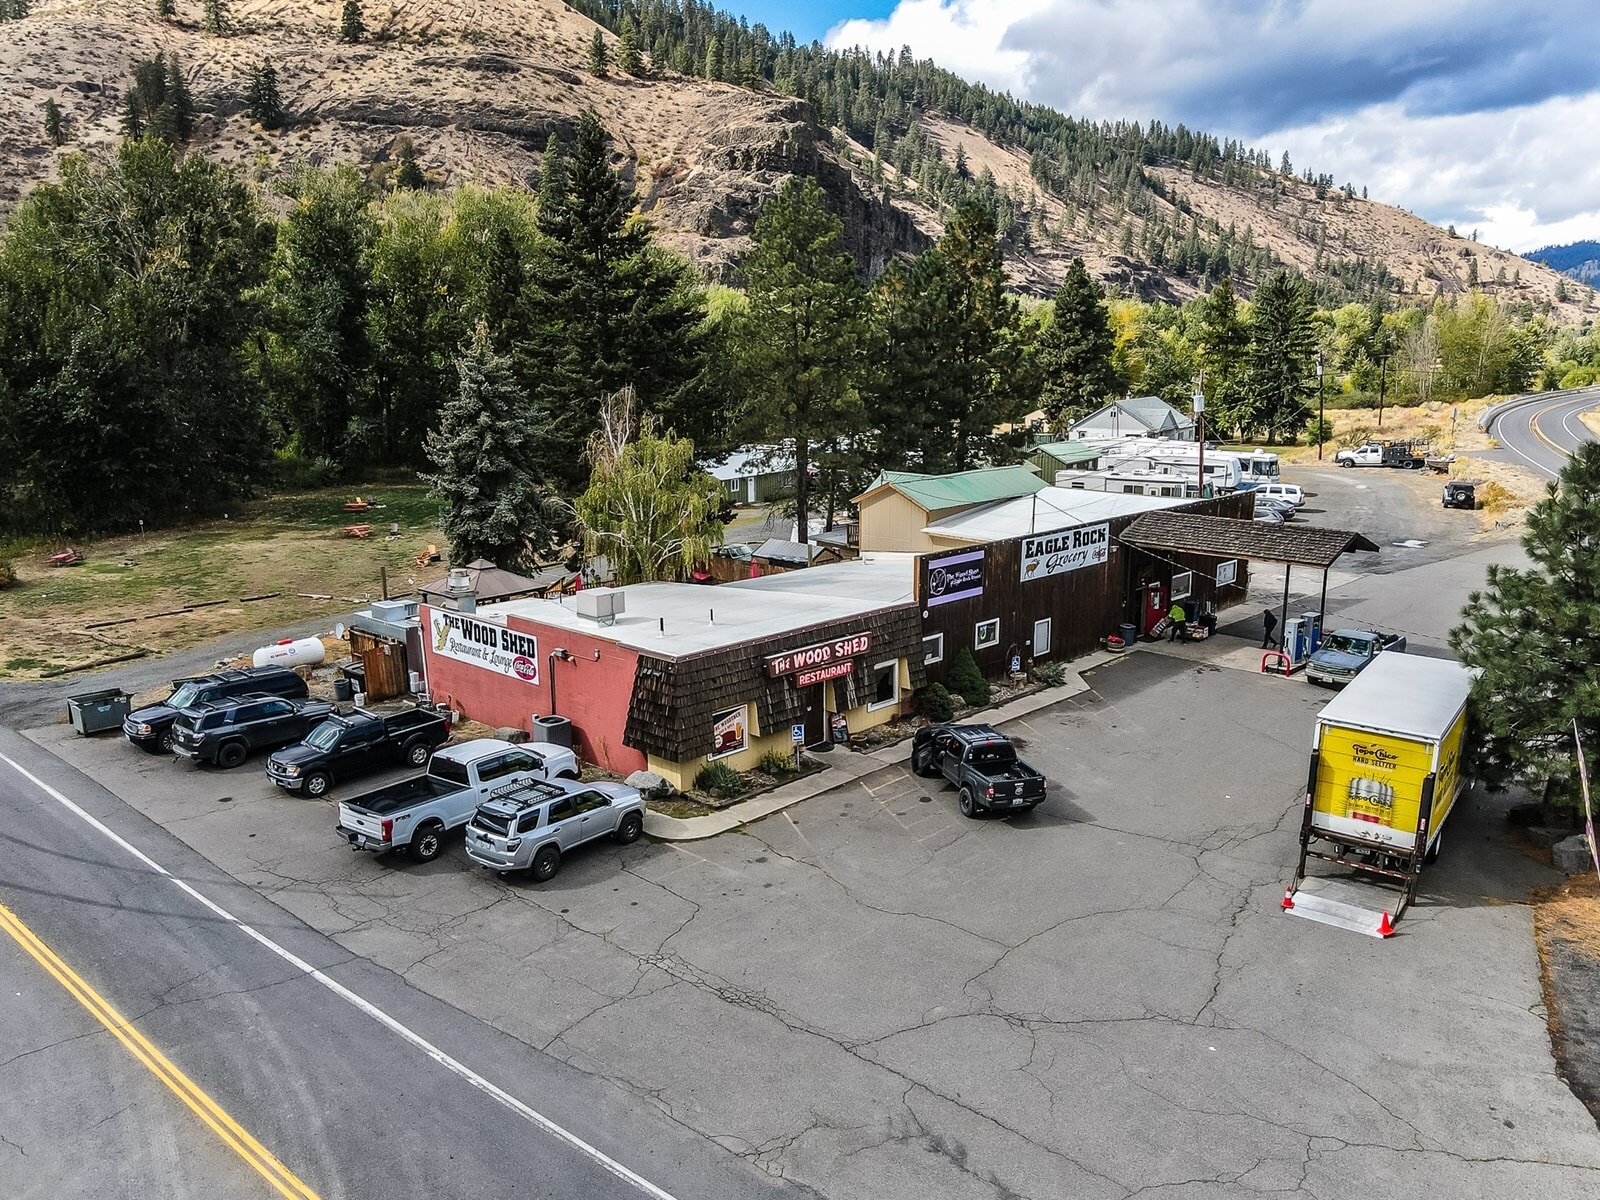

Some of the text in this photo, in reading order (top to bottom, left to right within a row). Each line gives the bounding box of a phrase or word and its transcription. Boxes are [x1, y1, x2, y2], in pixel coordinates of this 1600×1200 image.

[1025, 527, 1106, 559] EAGLE ROCK
[1045, 549, 1089, 575] Grocery
[443, 614, 536, 659] THE WOOD SHED
[450, 637, 513, 674] Restaurant & Lounge
[793, 646, 831, 669] WOOD
[835, 636, 868, 658] SHED
[799, 662, 852, 685] RESTAURANT
[1352, 744, 1398, 761] Topo Chico
[1371, 759, 1397, 770] SELTZER
